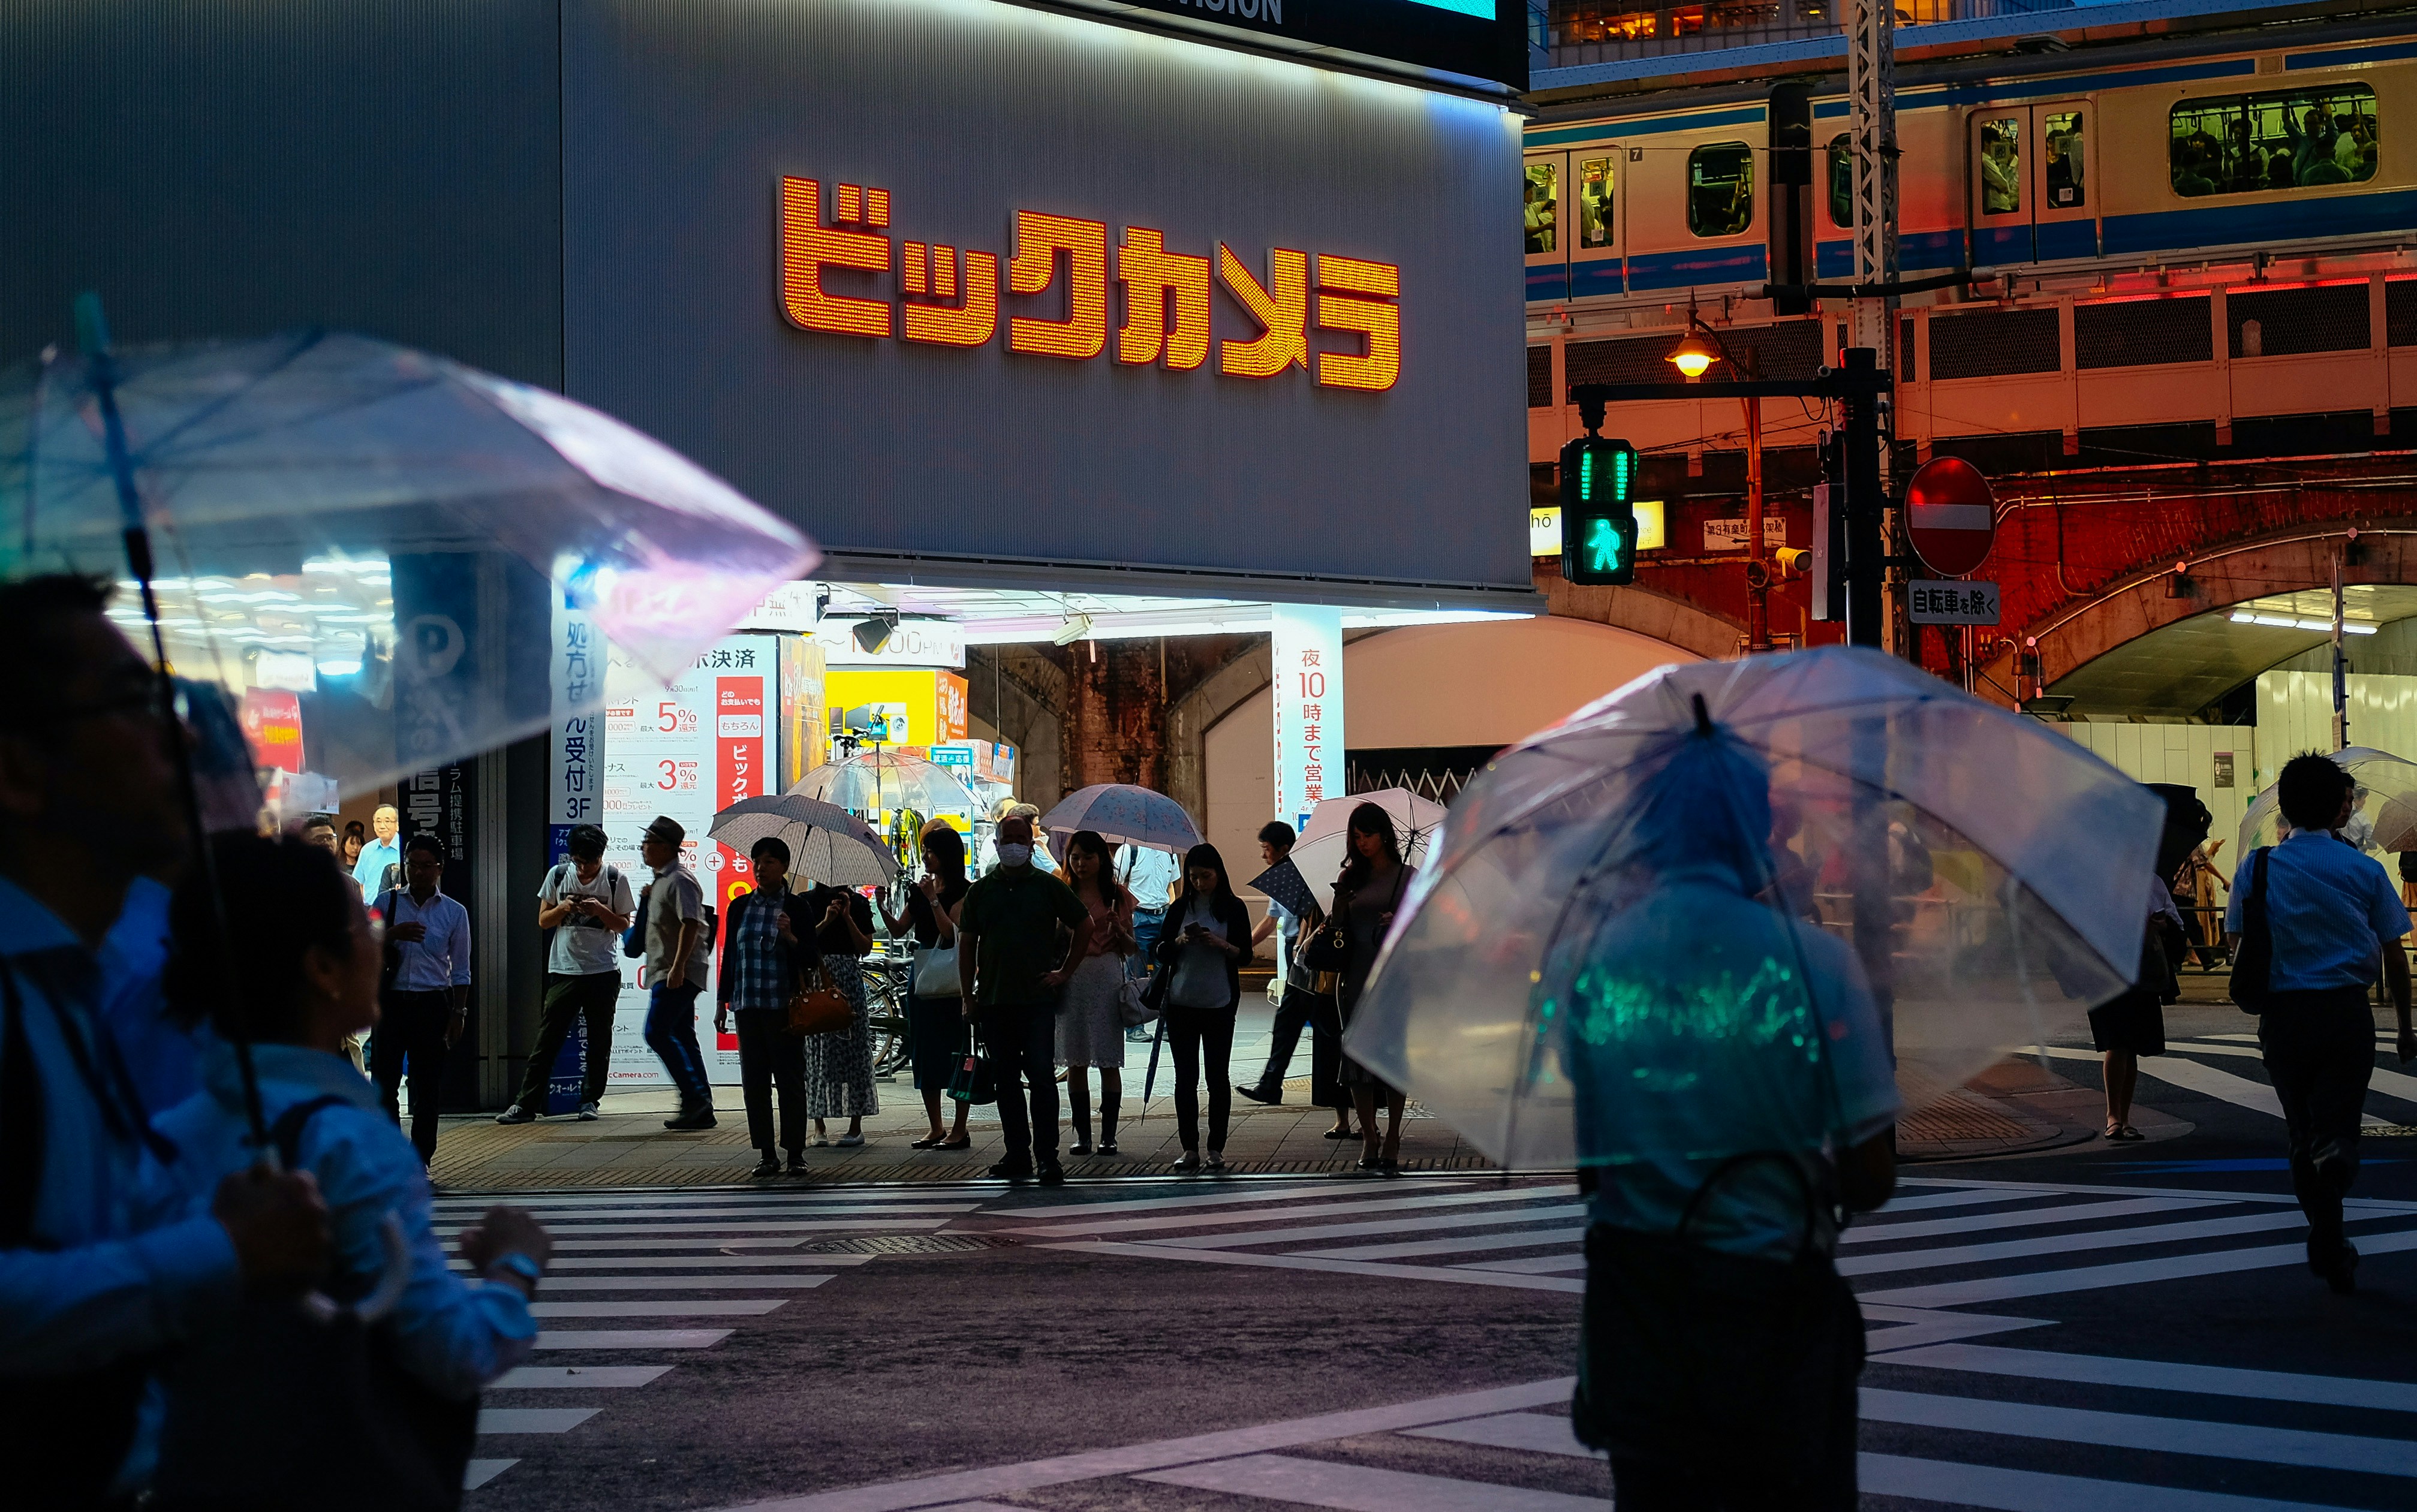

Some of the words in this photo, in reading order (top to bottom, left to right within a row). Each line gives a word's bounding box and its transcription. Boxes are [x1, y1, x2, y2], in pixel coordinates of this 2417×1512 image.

[1632, 149, 1640, 159] 7
[781, 174, 1401, 392] ビックカメラ
[1913, 588, 1995, 616] 自転車を除く
[721, 721, 759, 731] もちろん
[1299, 649, 1325, 802] 夜10時まで営業
[566, 797, 591, 818] 3F
